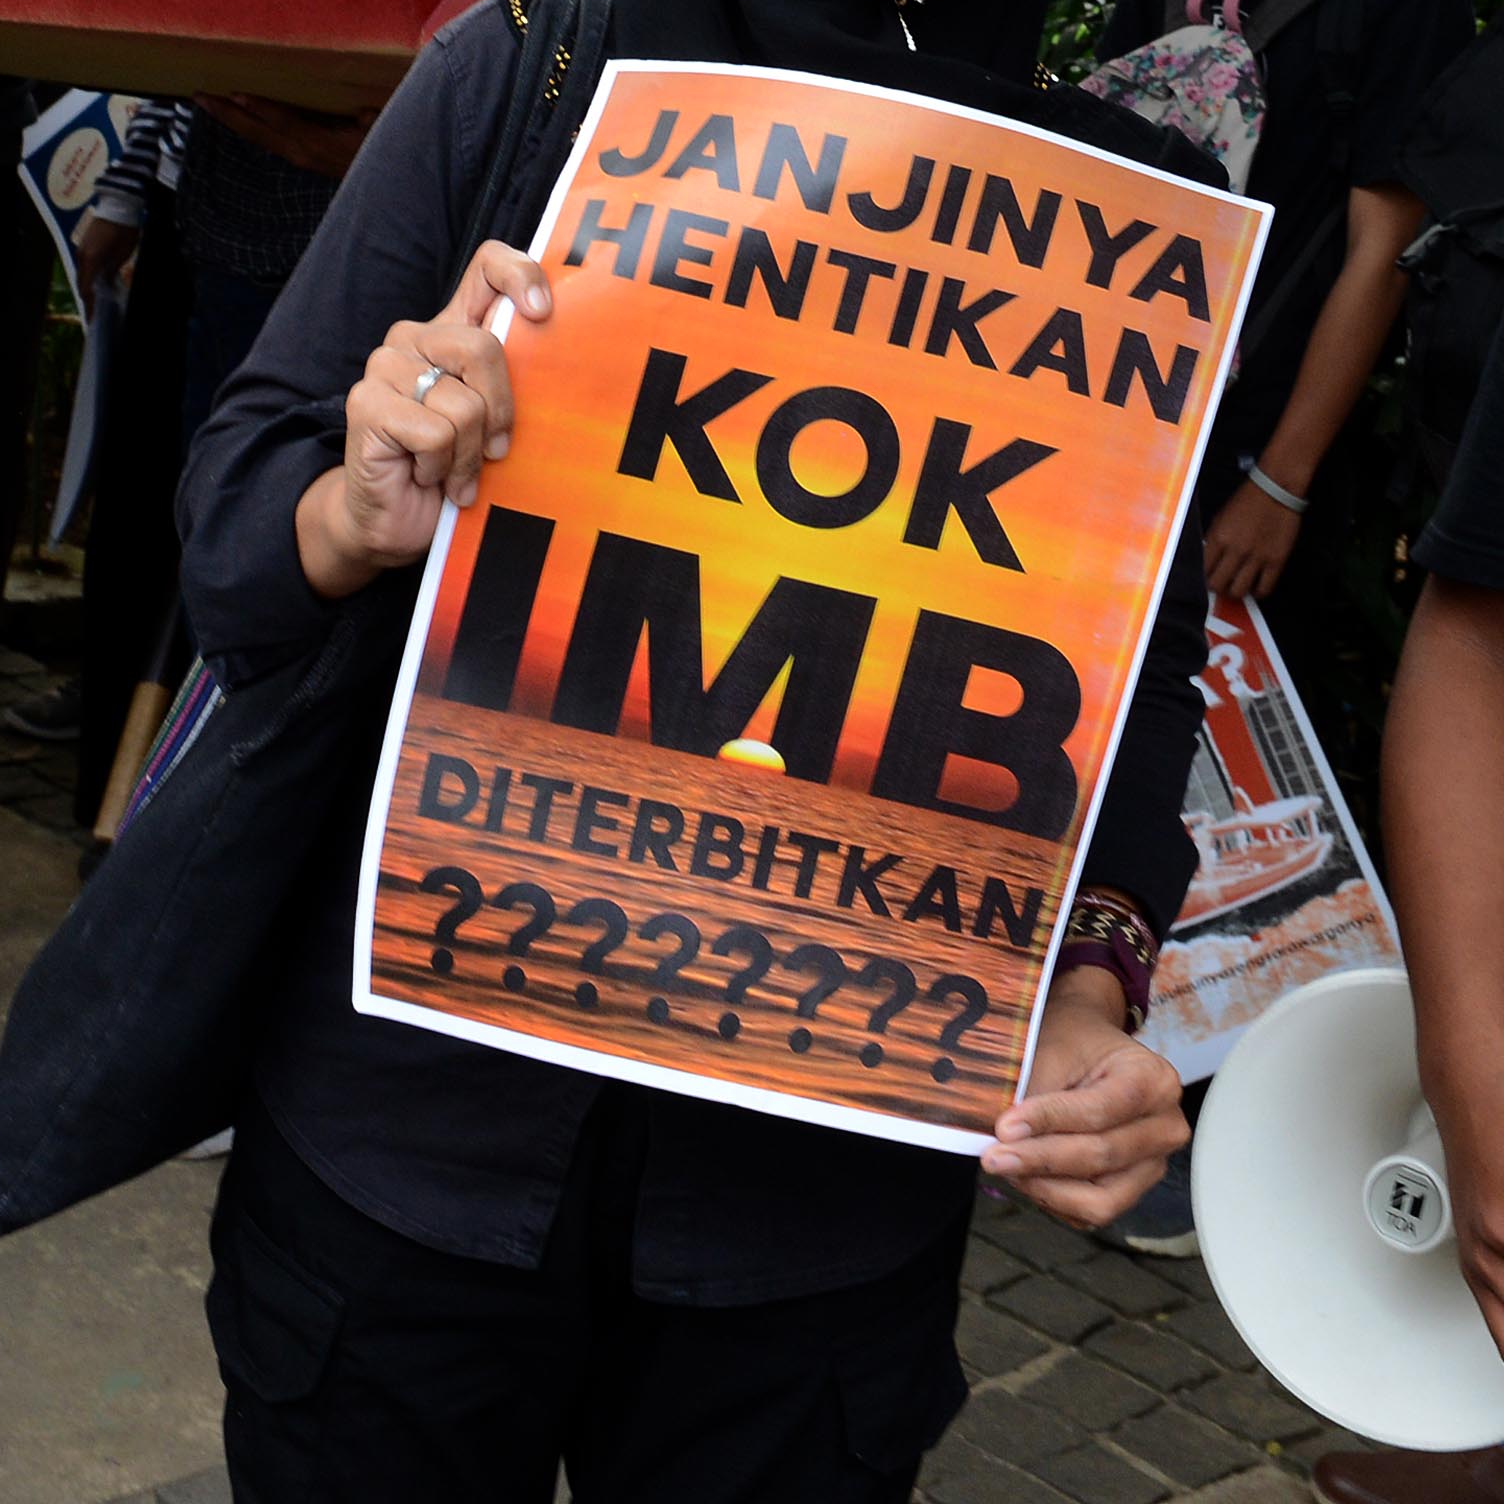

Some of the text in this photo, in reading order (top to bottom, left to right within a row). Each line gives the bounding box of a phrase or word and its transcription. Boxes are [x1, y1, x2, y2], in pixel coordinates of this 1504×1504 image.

[561, 199, 1201, 426] HENTIKAN
[597, 108, 1212, 323] JANJINYA
[615, 347, 1060, 573] KOK
[440, 502, 1083, 842] IMB
[417, 751, 1047, 949] DITERBITKAN
